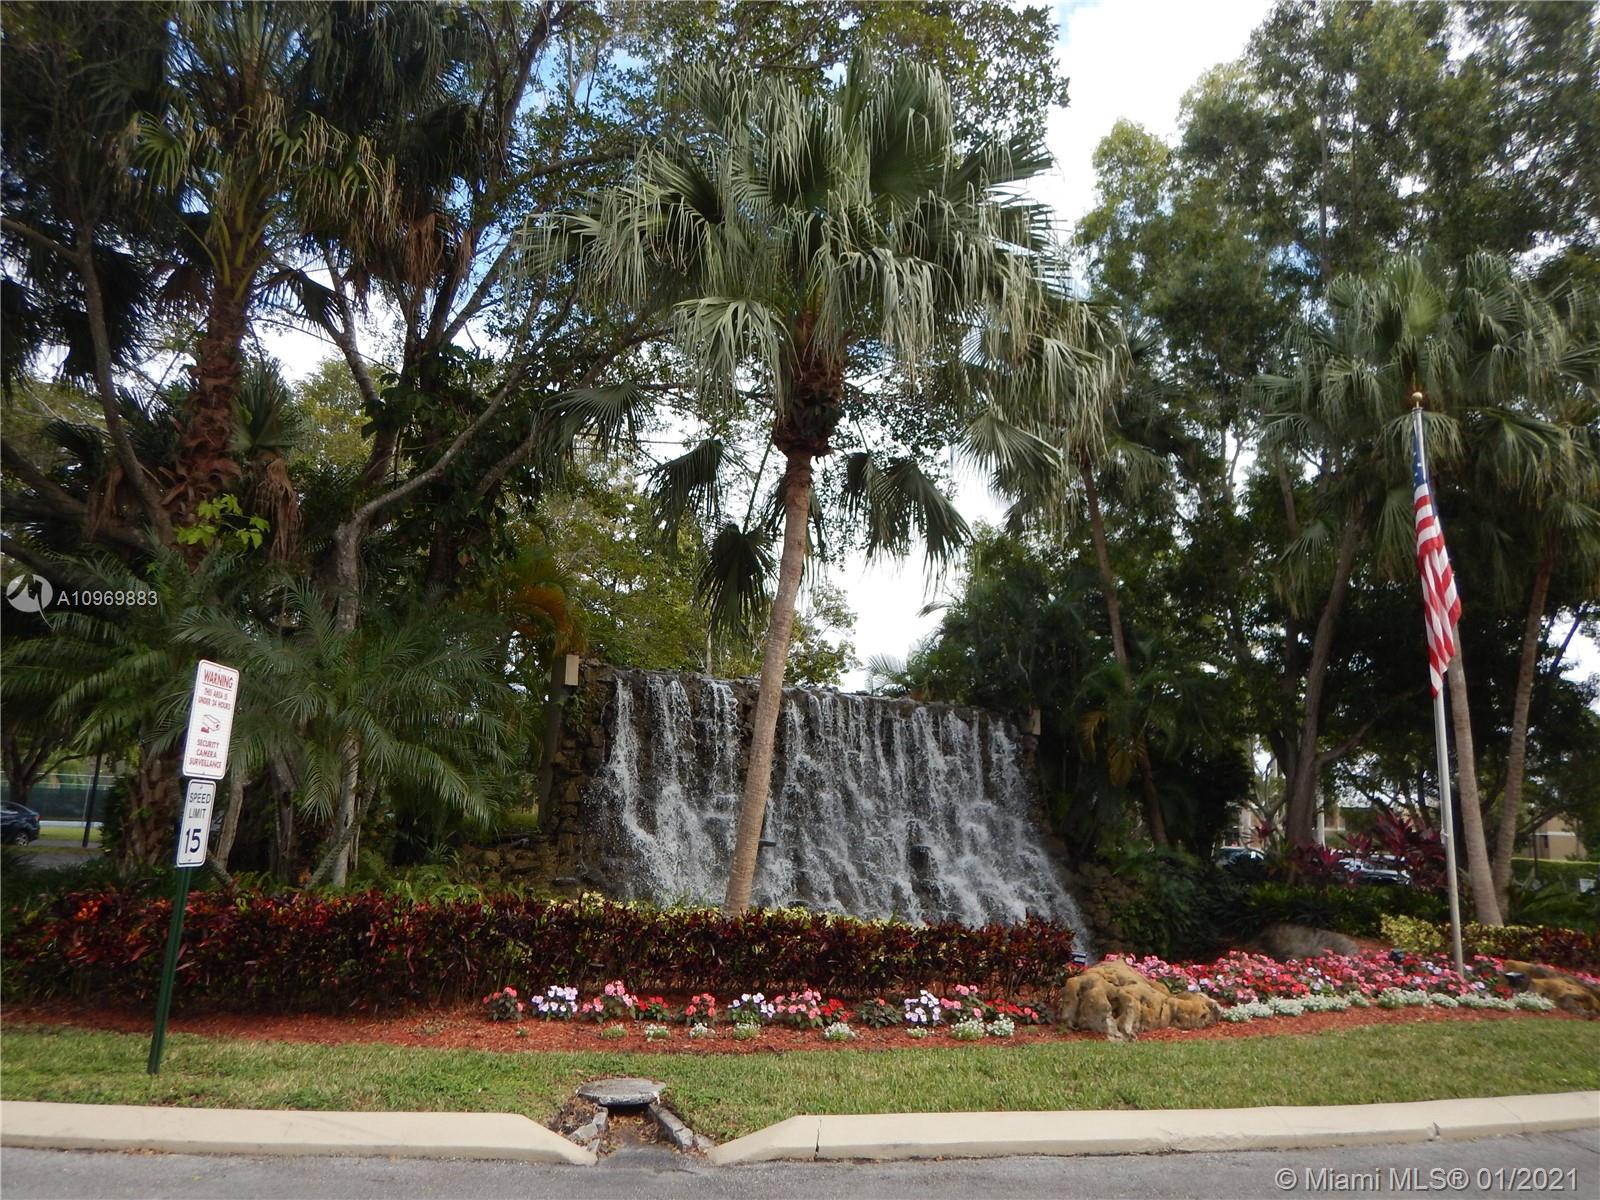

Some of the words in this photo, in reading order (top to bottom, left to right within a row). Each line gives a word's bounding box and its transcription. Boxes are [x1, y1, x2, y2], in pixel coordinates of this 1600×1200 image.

[204, 670, 233, 688] WARNING
[218, 701, 231, 710] HOURS
[197, 739, 220, 749] SECURITY
[196, 749, 217, 758] CAMERA
[189, 757, 222, 769] SURVEILLANCE
[189, 792, 211, 804] SPEED
[188, 807, 207, 819] LIMIT
[185, 828, 202, 854] 15
